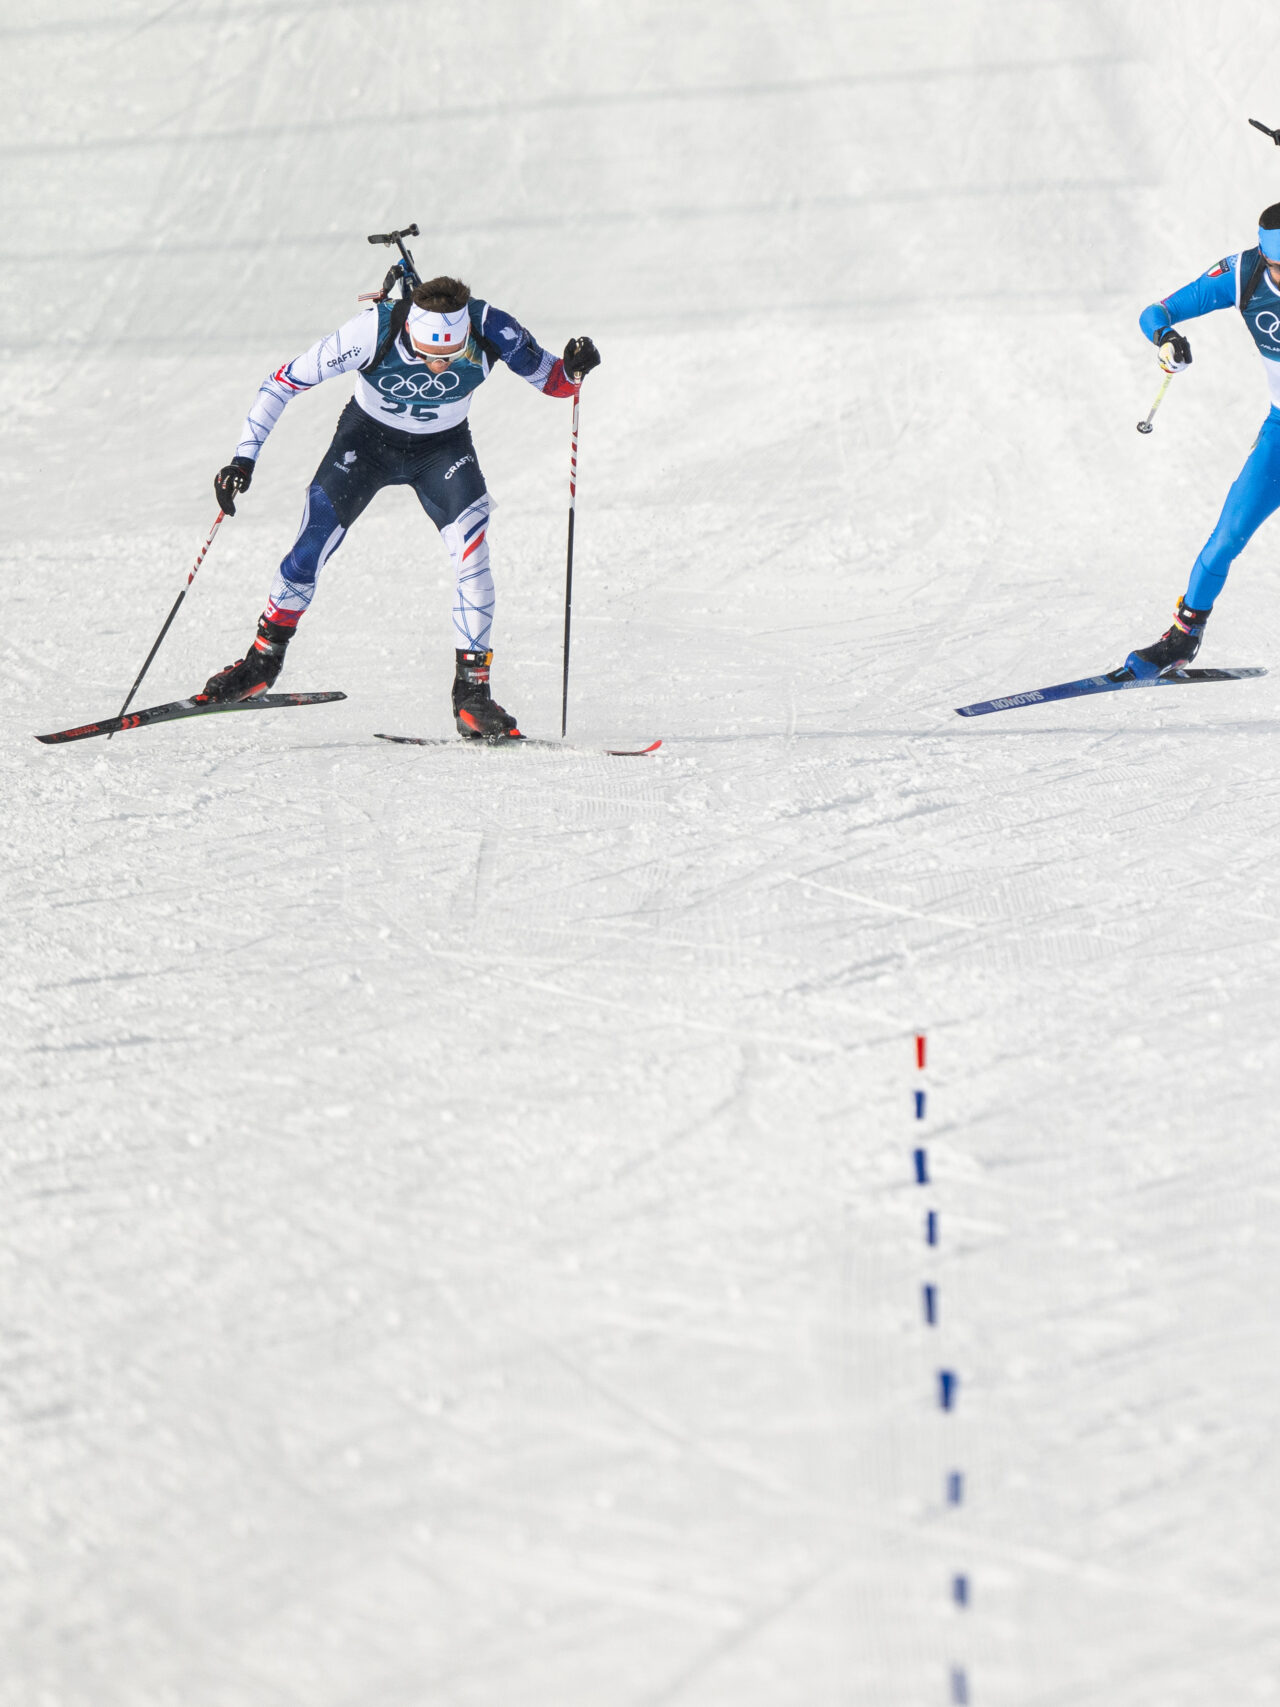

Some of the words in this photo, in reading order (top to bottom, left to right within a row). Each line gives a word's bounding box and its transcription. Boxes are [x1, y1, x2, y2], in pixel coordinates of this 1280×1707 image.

[326, 350, 353, 368] CRAFT
[379, 396, 440, 422] 25
[444, 455, 470, 480] CRAFT
[990, 690, 1045, 710] SALOMON
